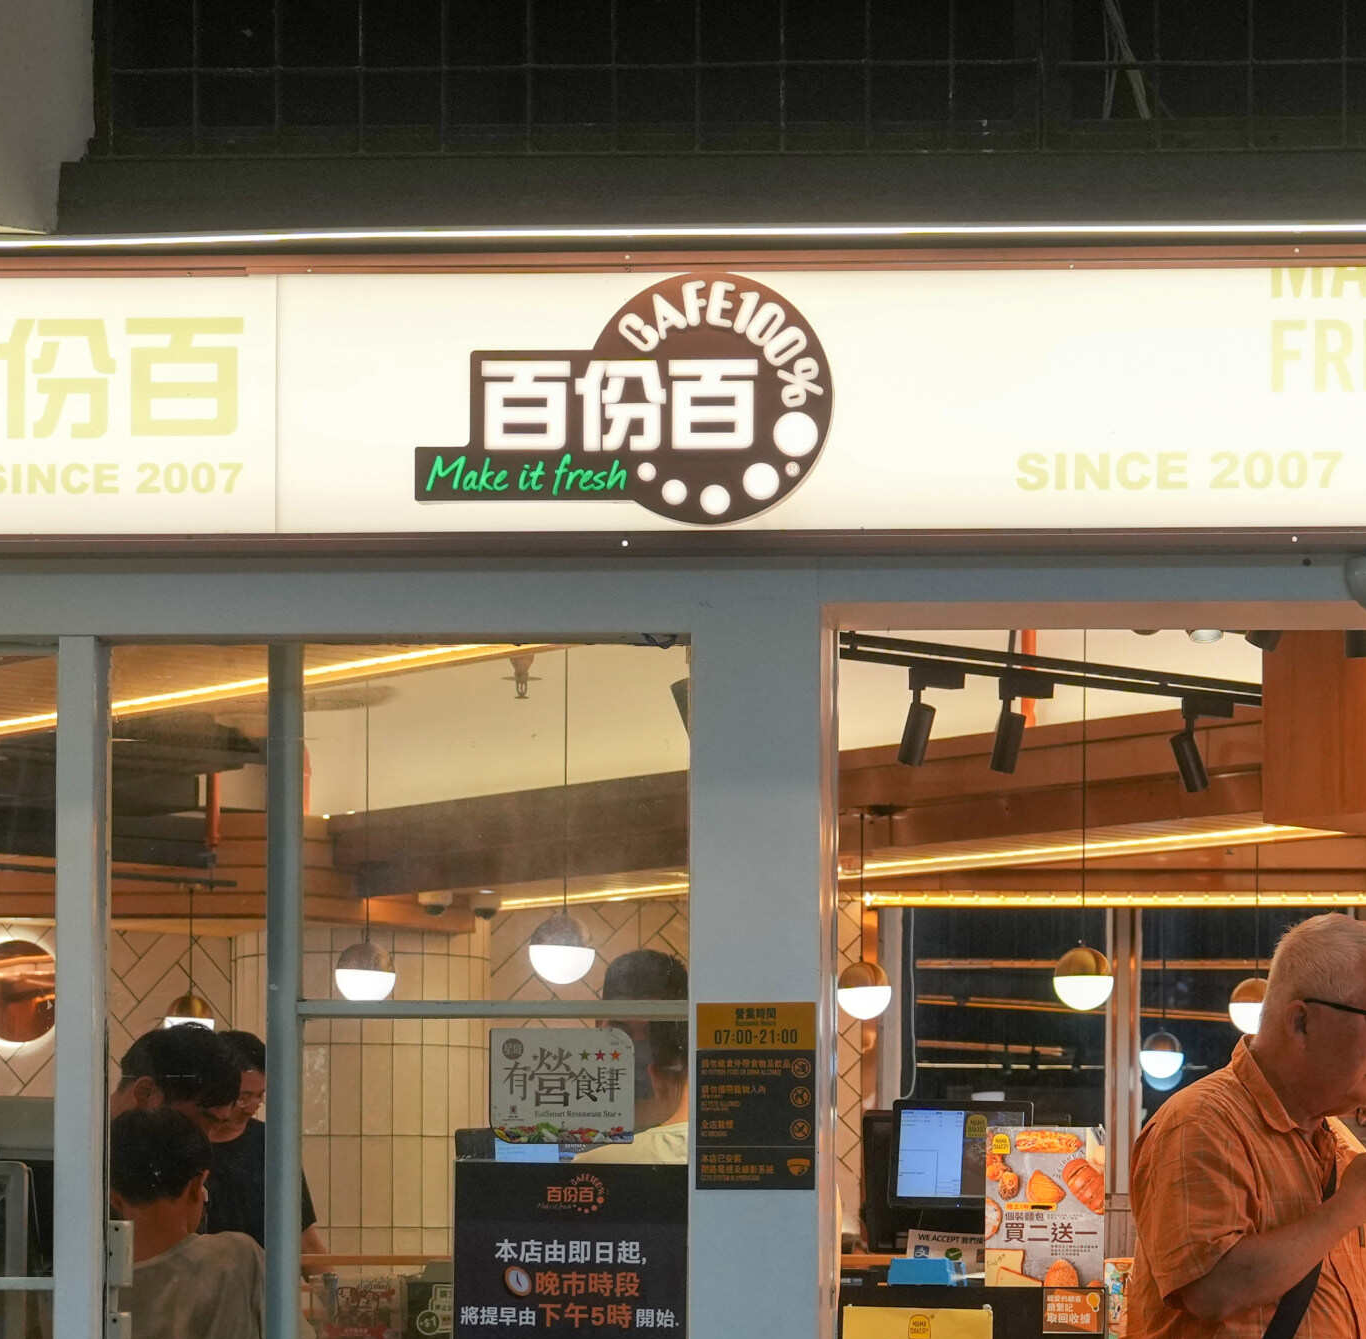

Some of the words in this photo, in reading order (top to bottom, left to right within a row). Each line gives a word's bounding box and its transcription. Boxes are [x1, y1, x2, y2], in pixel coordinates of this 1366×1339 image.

[619, 281, 825, 409] CAFE100%
[481, 358, 760, 451] 百份百
[135, 462, 244, 496] 2007
[425, 455, 509, 497] Make
[517, 458, 545, 493] it
[549, 456, 628, 499] fresh
[1016, 452, 1190, 491] SINCE
[1209, 452, 1343, 490] 2007
[714, 1029, 798, 1045] 07:00-21:00
[503, 1047, 628, 1107] 有營食肆
[547, 1186, 594, 1202] 百份百
[1004, 1222, 1098, 1243] 買二送一
[495, 1239, 647, 1265] 本店由即日起,
[535, 1271, 640, 1298] 晚市時段
